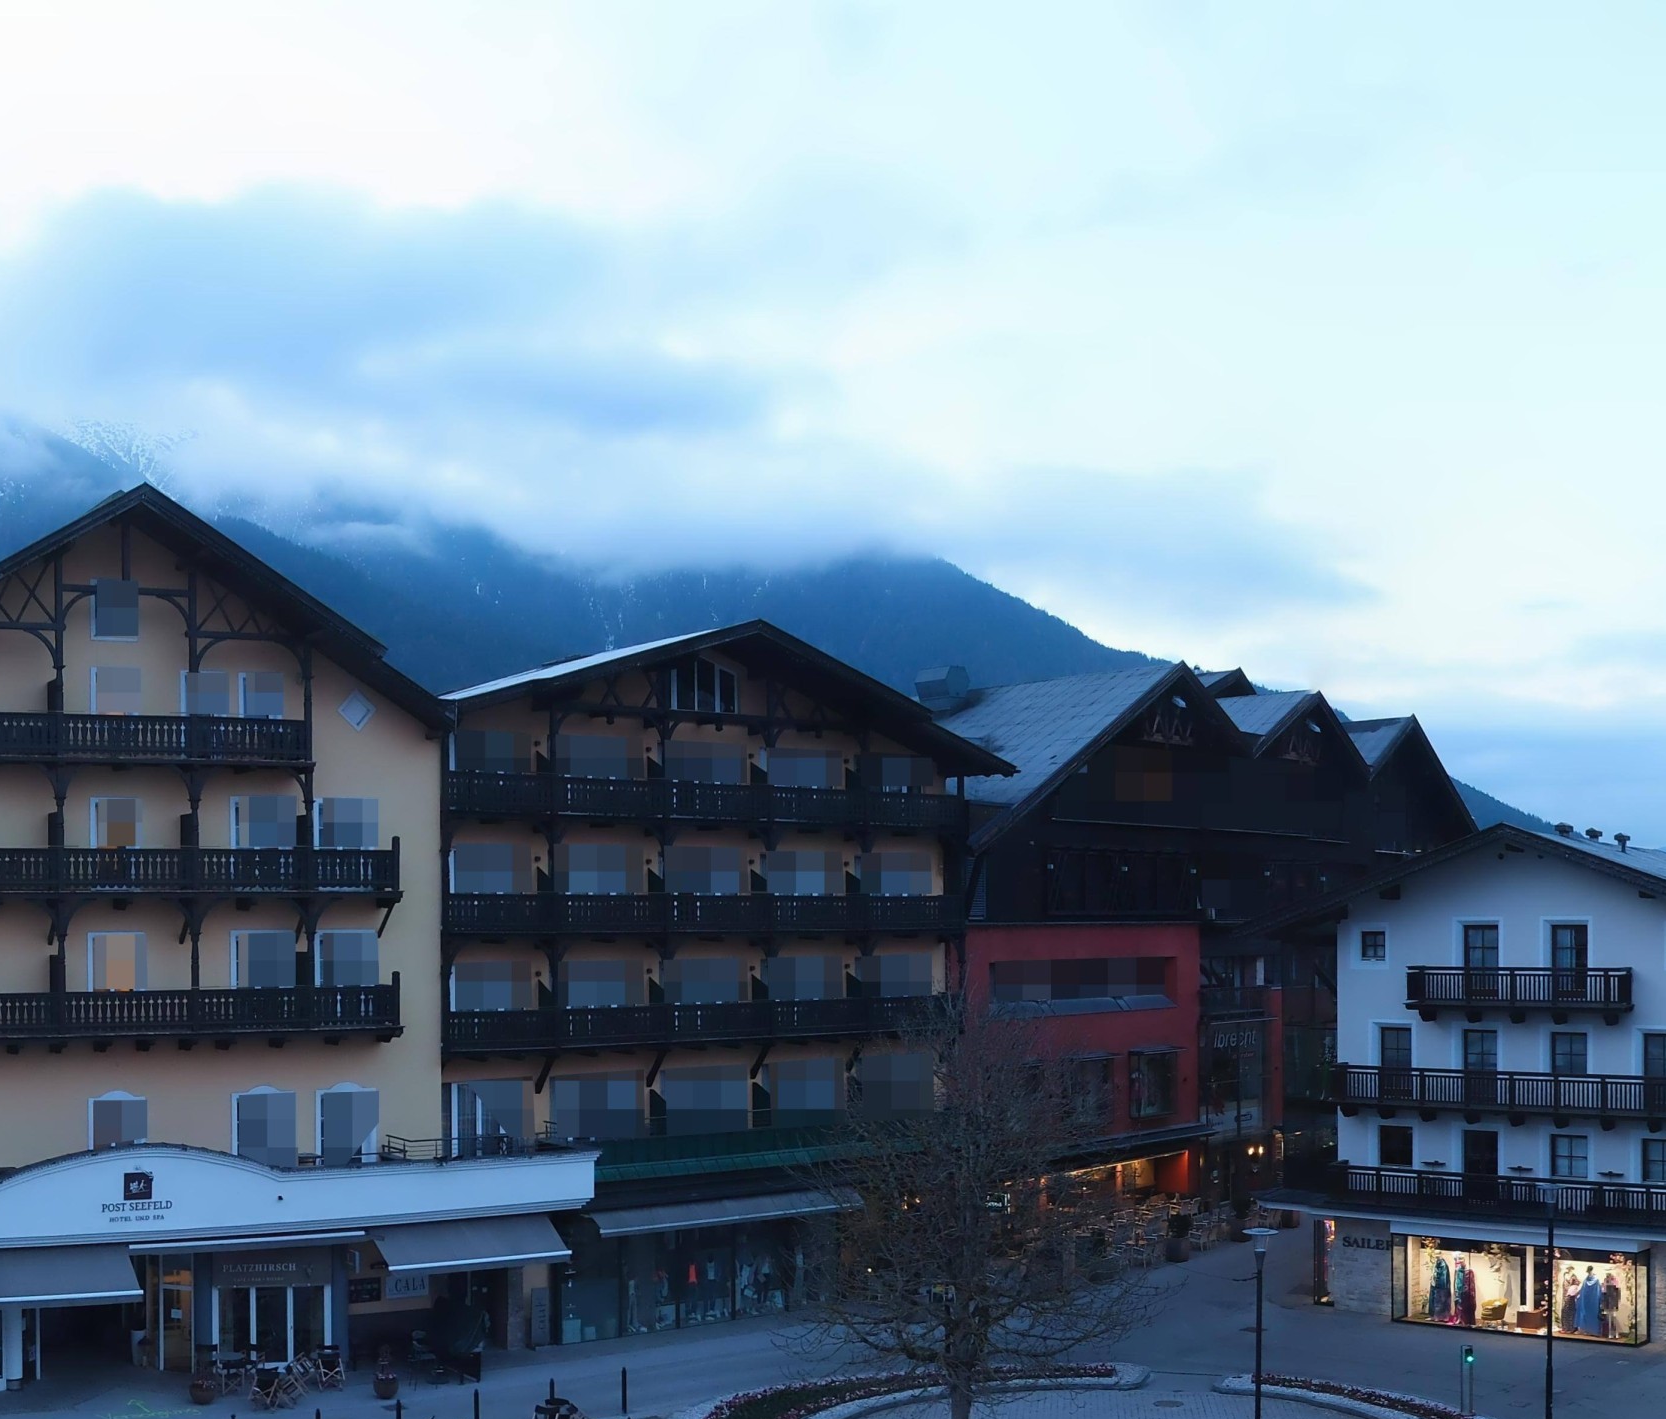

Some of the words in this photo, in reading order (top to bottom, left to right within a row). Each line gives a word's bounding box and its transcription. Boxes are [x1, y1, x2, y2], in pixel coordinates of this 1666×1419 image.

[101, 1202, 127, 1213] POST
[128, 1200, 173, 1212] SEEFELD
[222, 1262, 297, 1273] PLATZHIRSCH
[394, 1277, 426, 1292] CALA
